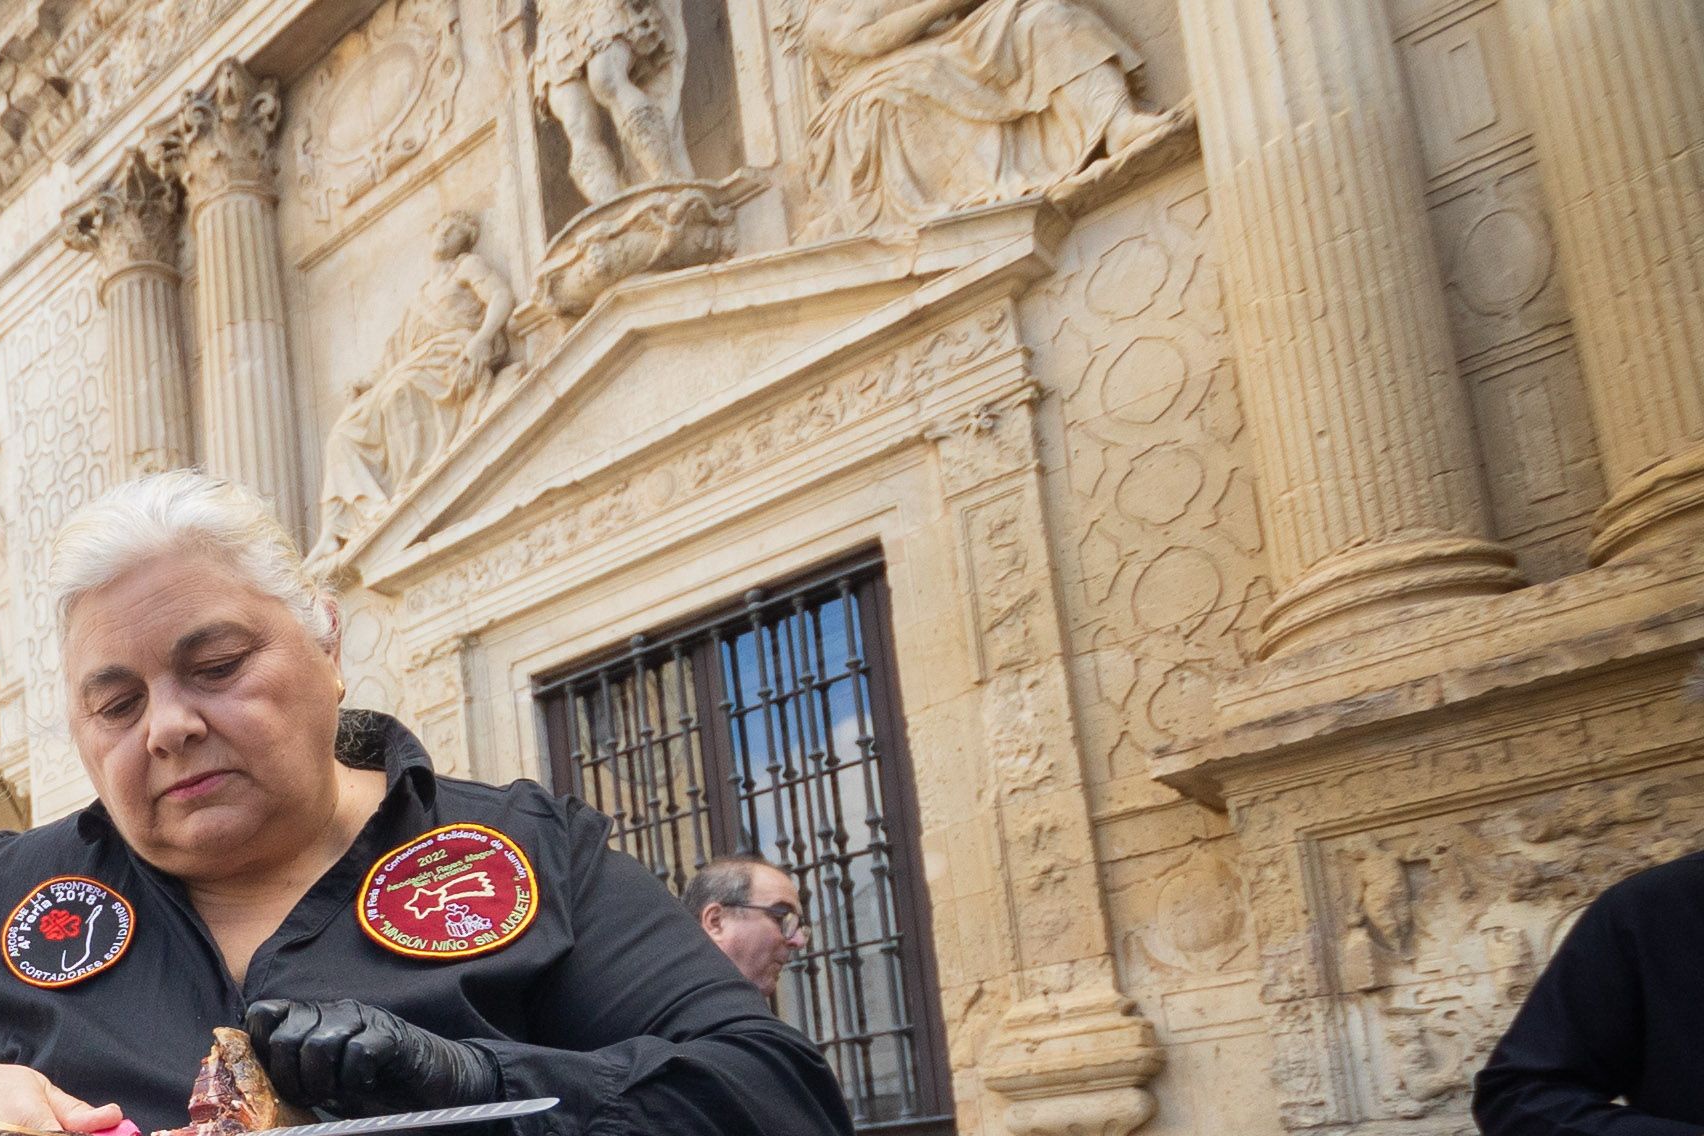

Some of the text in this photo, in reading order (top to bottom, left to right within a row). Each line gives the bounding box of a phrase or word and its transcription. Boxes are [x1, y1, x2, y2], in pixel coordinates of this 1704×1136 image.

[437, 830, 488, 842] Solidarios
[490, 839, 504, 850] de
[417, 849, 448, 867] 2022
[7, 881, 108, 957] ARCOS DE LA FRONTERA
[20, 899, 53, 931] Feria
[55, 890, 98, 906] 2018
[19, 901, 129, 982] CORTADORES SOLIDARIOS
[431, 939, 469, 951] NIÑO
[474, 930, 499, 946] SIN
